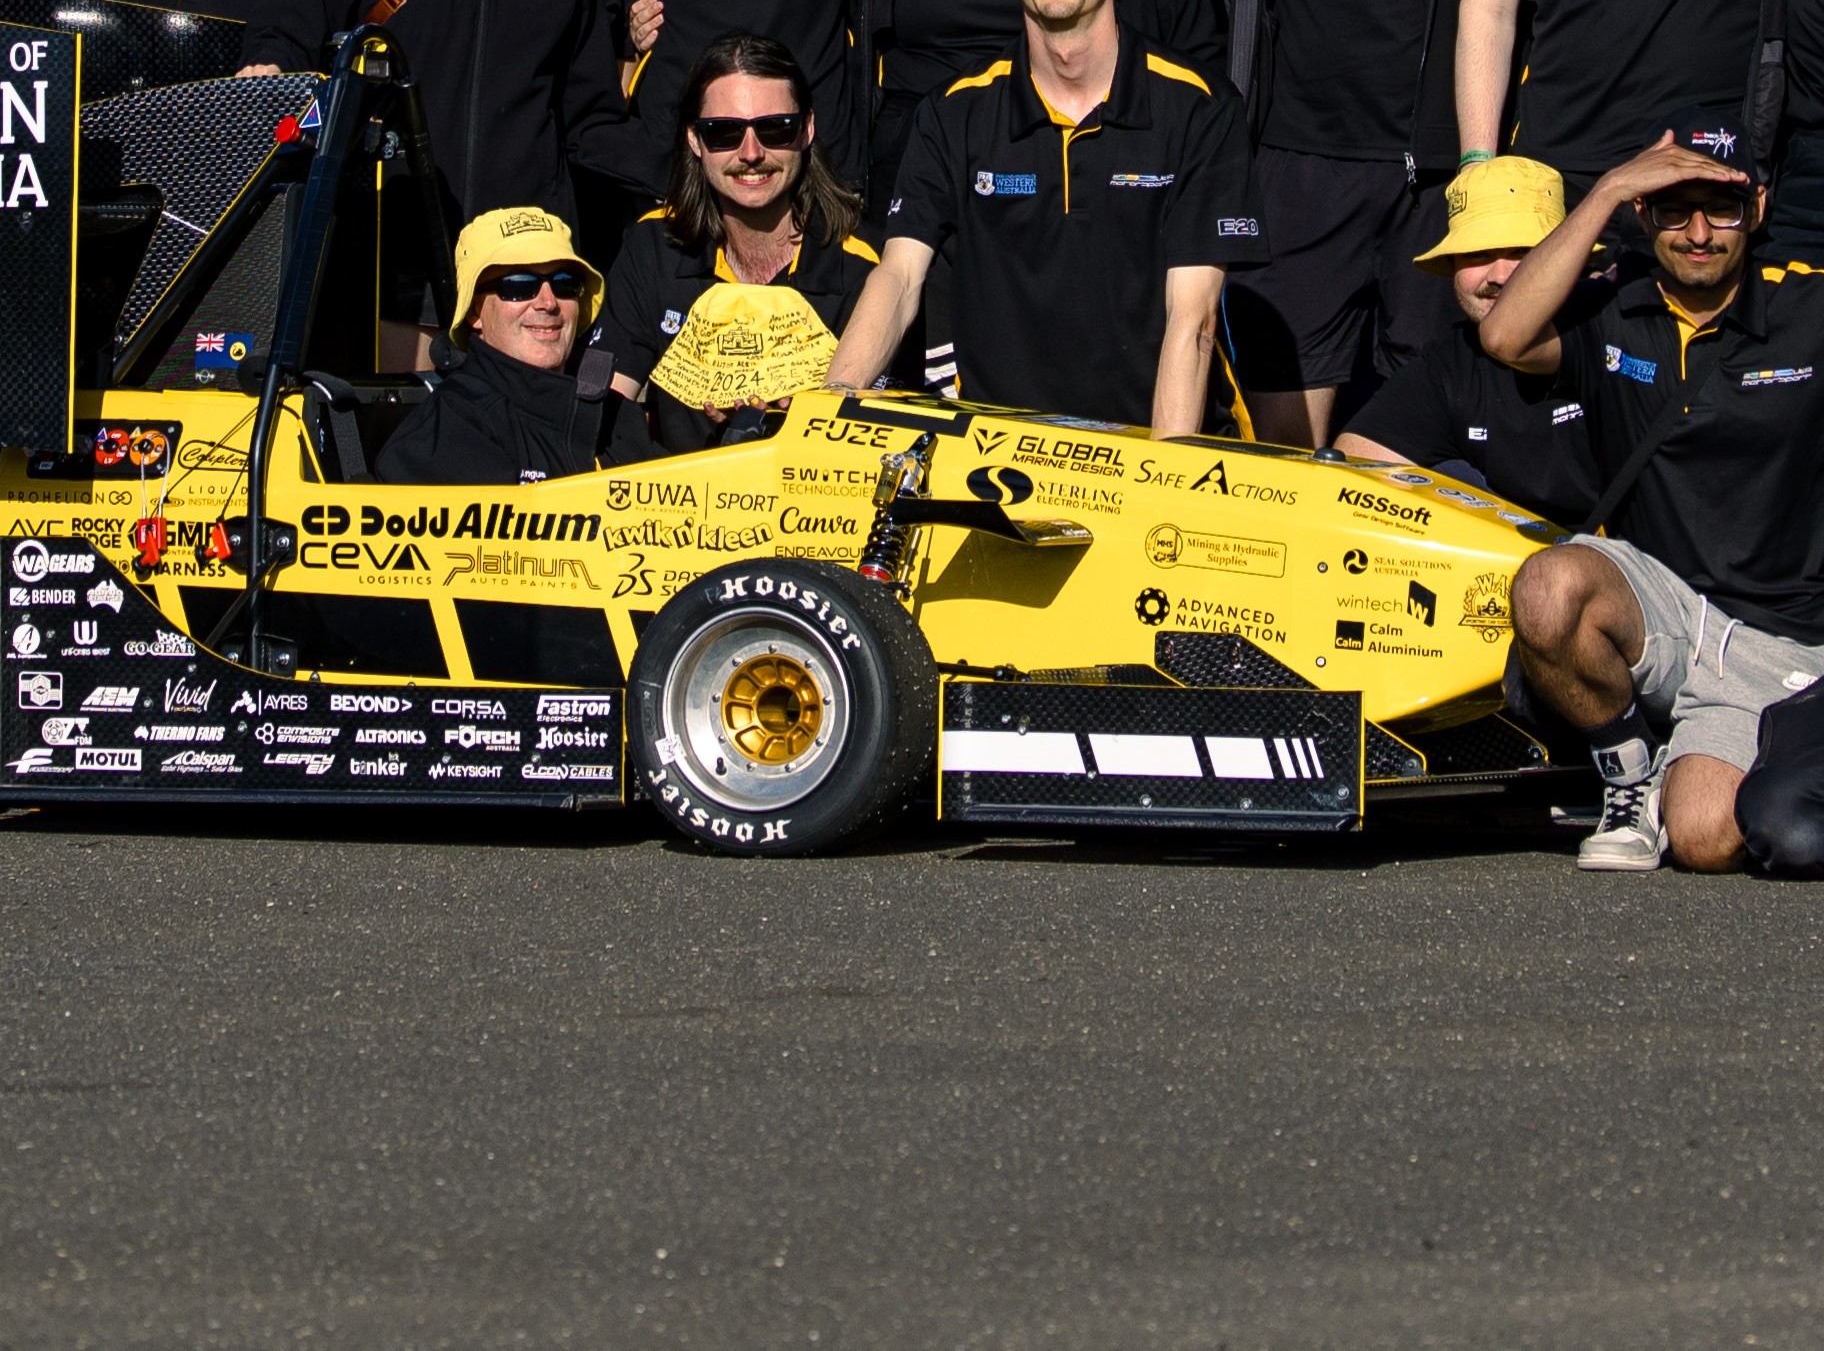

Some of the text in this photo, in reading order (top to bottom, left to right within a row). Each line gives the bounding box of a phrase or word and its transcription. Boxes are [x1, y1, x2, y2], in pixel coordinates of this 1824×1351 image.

[9, 40, 48, 72] OF
[1217, 218, 1259, 236] E20
[710, 369, 765, 393] 2024
[802, 417, 894, 449] FUZE
[1016, 435, 1125, 467] GLOBAL
[1011, 453, 1125, 478] MARINE DESIGN
[7, 491, 105, 505] PROHELION
[636, 482, 779, 513] UWA SPORT
[1036, 480, 1124, 507] STERLING
[1036, 494, 1121, 515] ELECTRO PLATING
[1336, 486, 1432, 527] KISSsoft
[71, 518, 126, 532] ROCKY
[360, 504, 450, 539] Dodd
[452, 502, 602, 542] Altium
[779, 506, 859, 536] Canva
[603, 518, 673, 552] kwik
[696, 521, 775, 552] kleen
[1186, 537, 1220, 553] Mining
[1232, 542, 1280, 559] Hydraulic
[12, 554, 48, 573] WA
[48, 553, 97, 574] GEARS
[1206, 552, 1248, 567] Supplies
[1373, 556, 1453, 572] SEAL SOLUTIONS
[358, 575, 432, 586] LOGISTICS
[1373, 566, 1420, 578] AUSTRALIA
[470, 577, 578, 590] AUTO PAINTS
[31, 588, 76, 605] BENDER
[1336, 594, 1403, 613] wintech
[720, 575, 862, 650] Hoosier
[1177, 597, 1275, 626] ADVANCED
[1175, 613, 1287, 644] NAVIGATION
[1369, 623, 1404, 637] Calm
[1335, 637, 1363, 649] Calm
[1367, 641, 1443, 659] Aluminium
[81, 686, 140, 706] AEM
[164, 676, 218, 714] Vivid
[263, 695, 308, 712] AYRES
[330, 694, 400, 713] BEYOND
[431, 698, 507, 715] CORSA
[536, 694, 612, 717] Fastron
[149, 725, 226, 742] THERMO FANS
[355, 729, 427, 744] ALTRONICS
[535, 726, 609, 749] Hoosier
[80, 752, 138, 768] MOTUL
[181, 750, 236, 769] Calspan
[262, 753, 336, 765] LEGACY
[349, 757, 408, 776] tinker
[305, 764, 332, 775] EV
[447, 765, 503, 779] KEYSIGHT
[569, 766, 613, 778] CABLES
[648, 768, 793, 844] Hoosier
